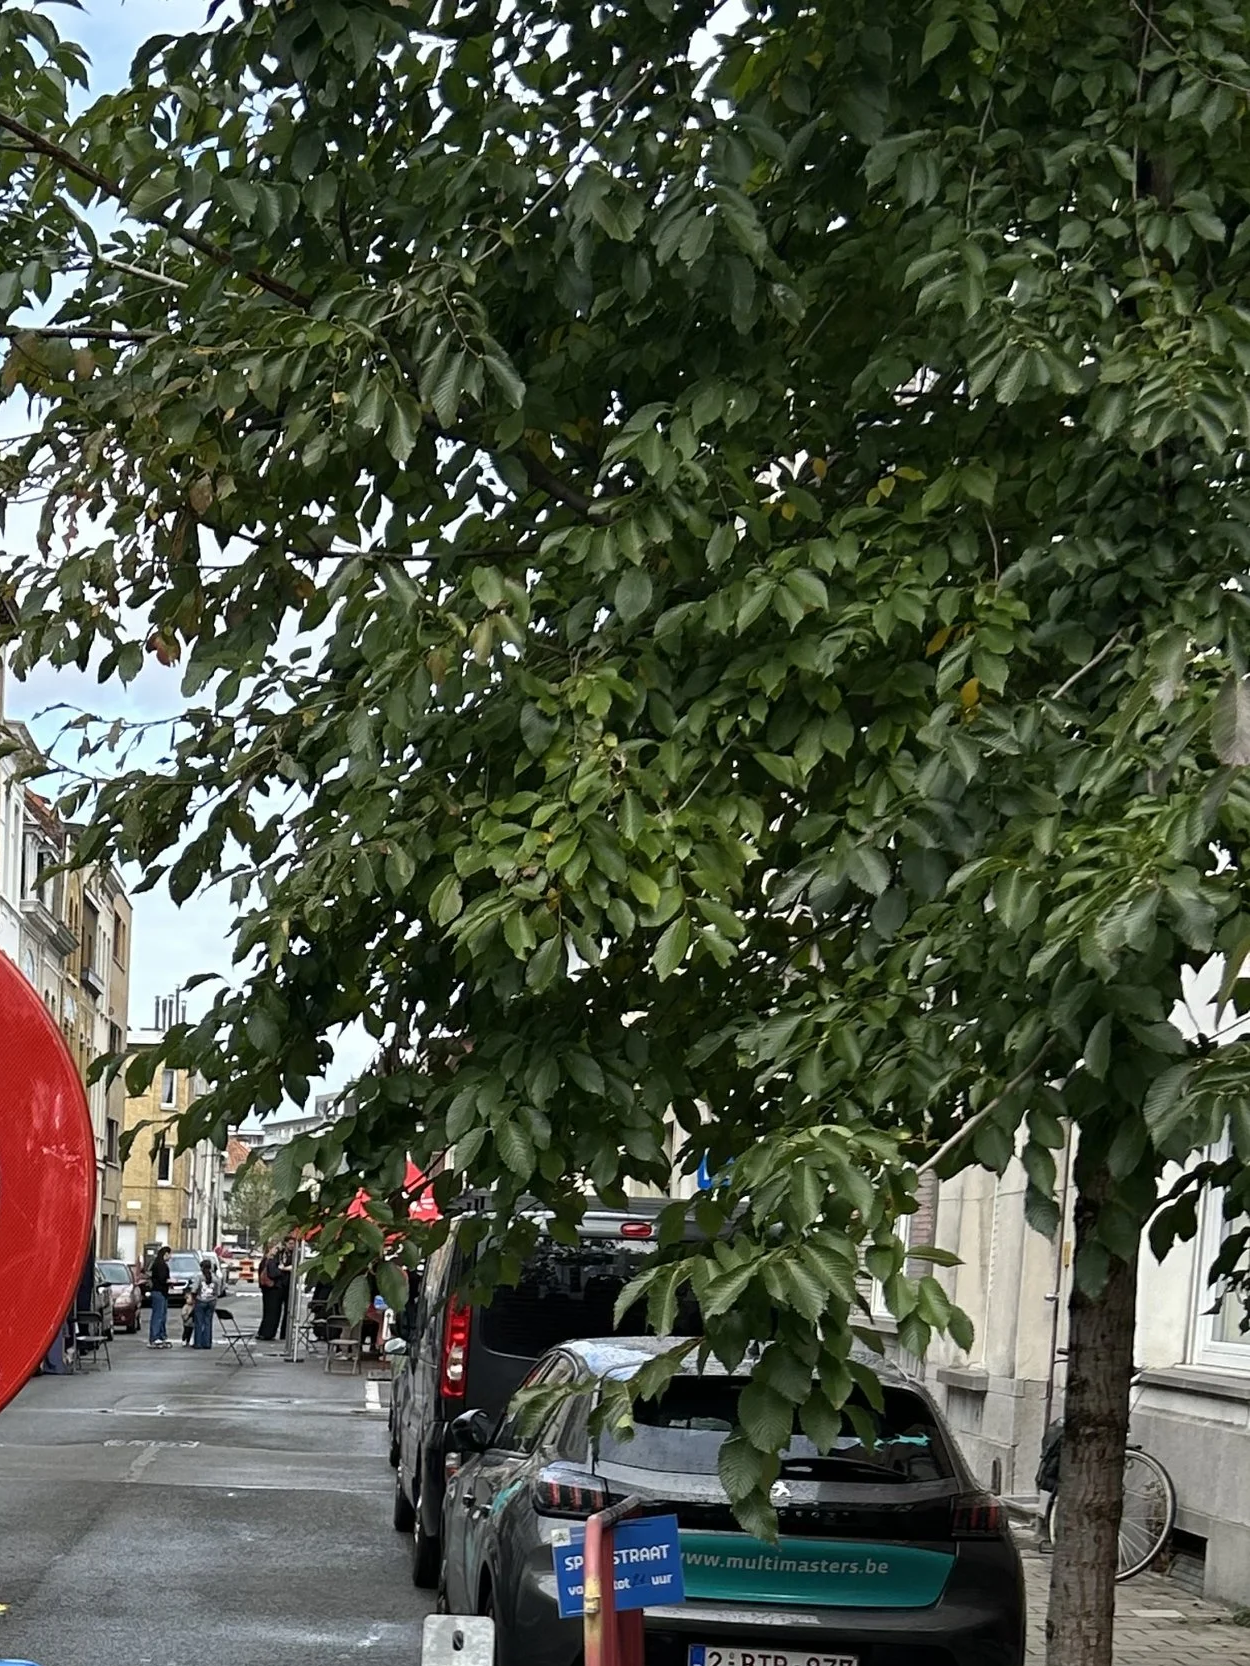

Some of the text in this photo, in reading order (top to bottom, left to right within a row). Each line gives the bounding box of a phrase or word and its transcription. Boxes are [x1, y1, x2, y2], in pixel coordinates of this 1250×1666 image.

[564, 1544, 670, 1572] SPSTRAAT
[681, 1551, 889, 1575] ww.multimasters.be
[651, 1574, 673, 1585] uur
